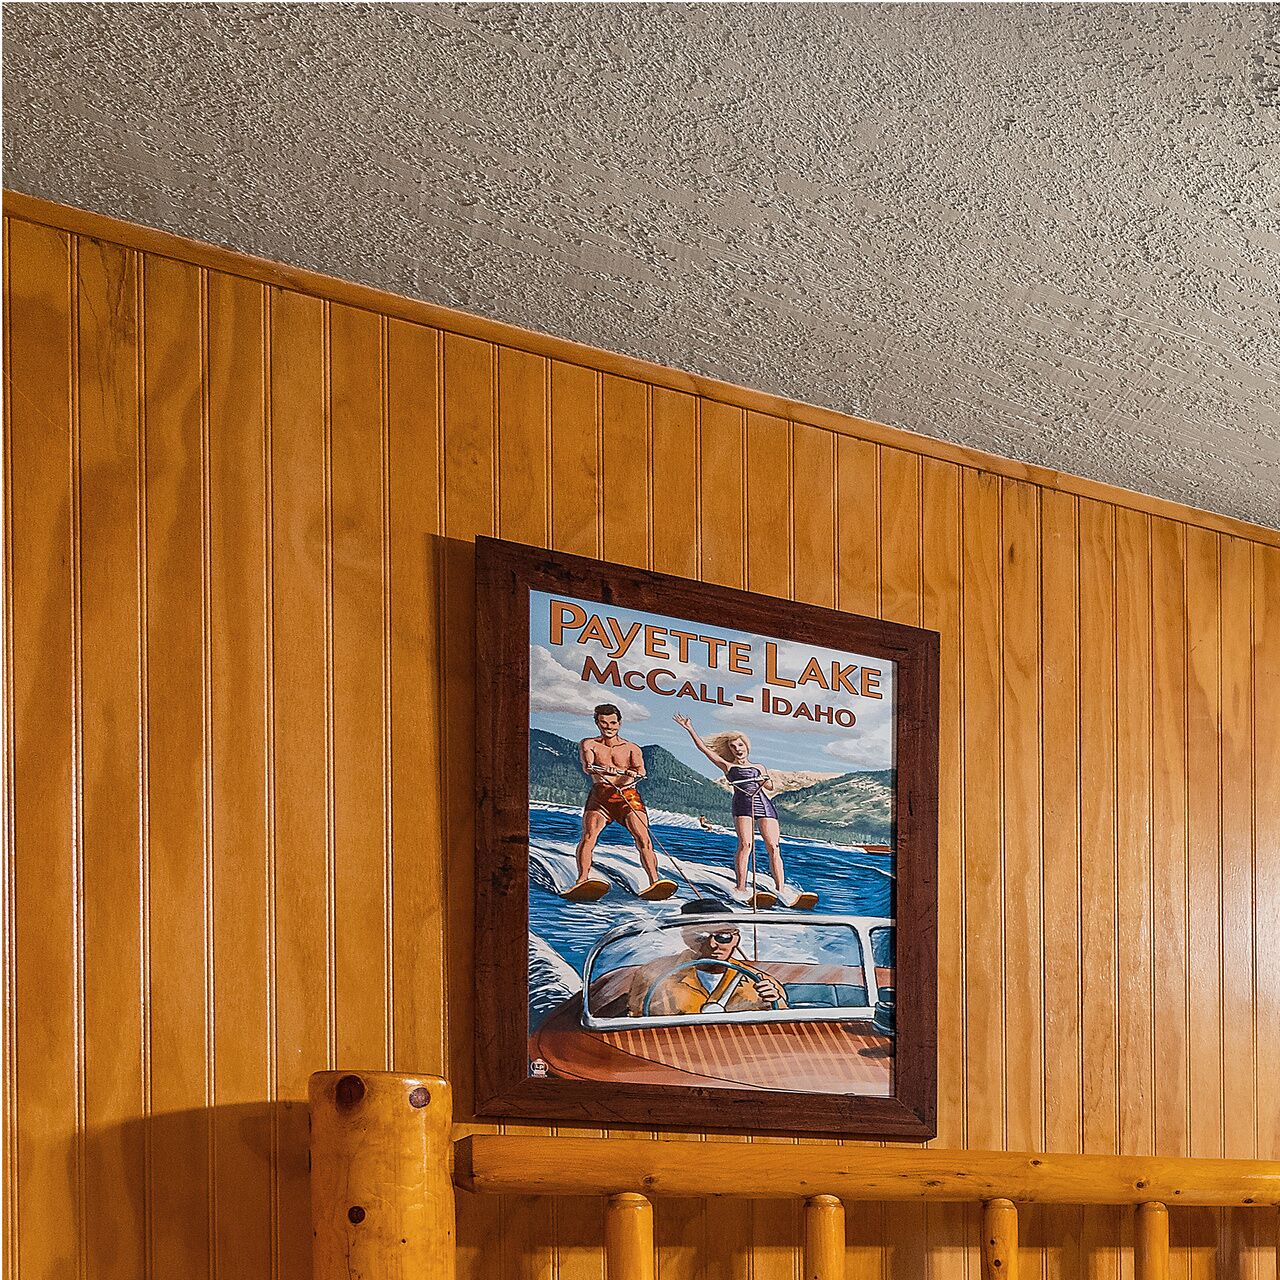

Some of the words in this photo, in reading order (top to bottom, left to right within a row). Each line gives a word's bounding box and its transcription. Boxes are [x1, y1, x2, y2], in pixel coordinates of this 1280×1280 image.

[549, 599, 754, 676] PAYETTE
[763, 641, 884, 700] LAKE
[760, 687, 857, 729] IDAHO
